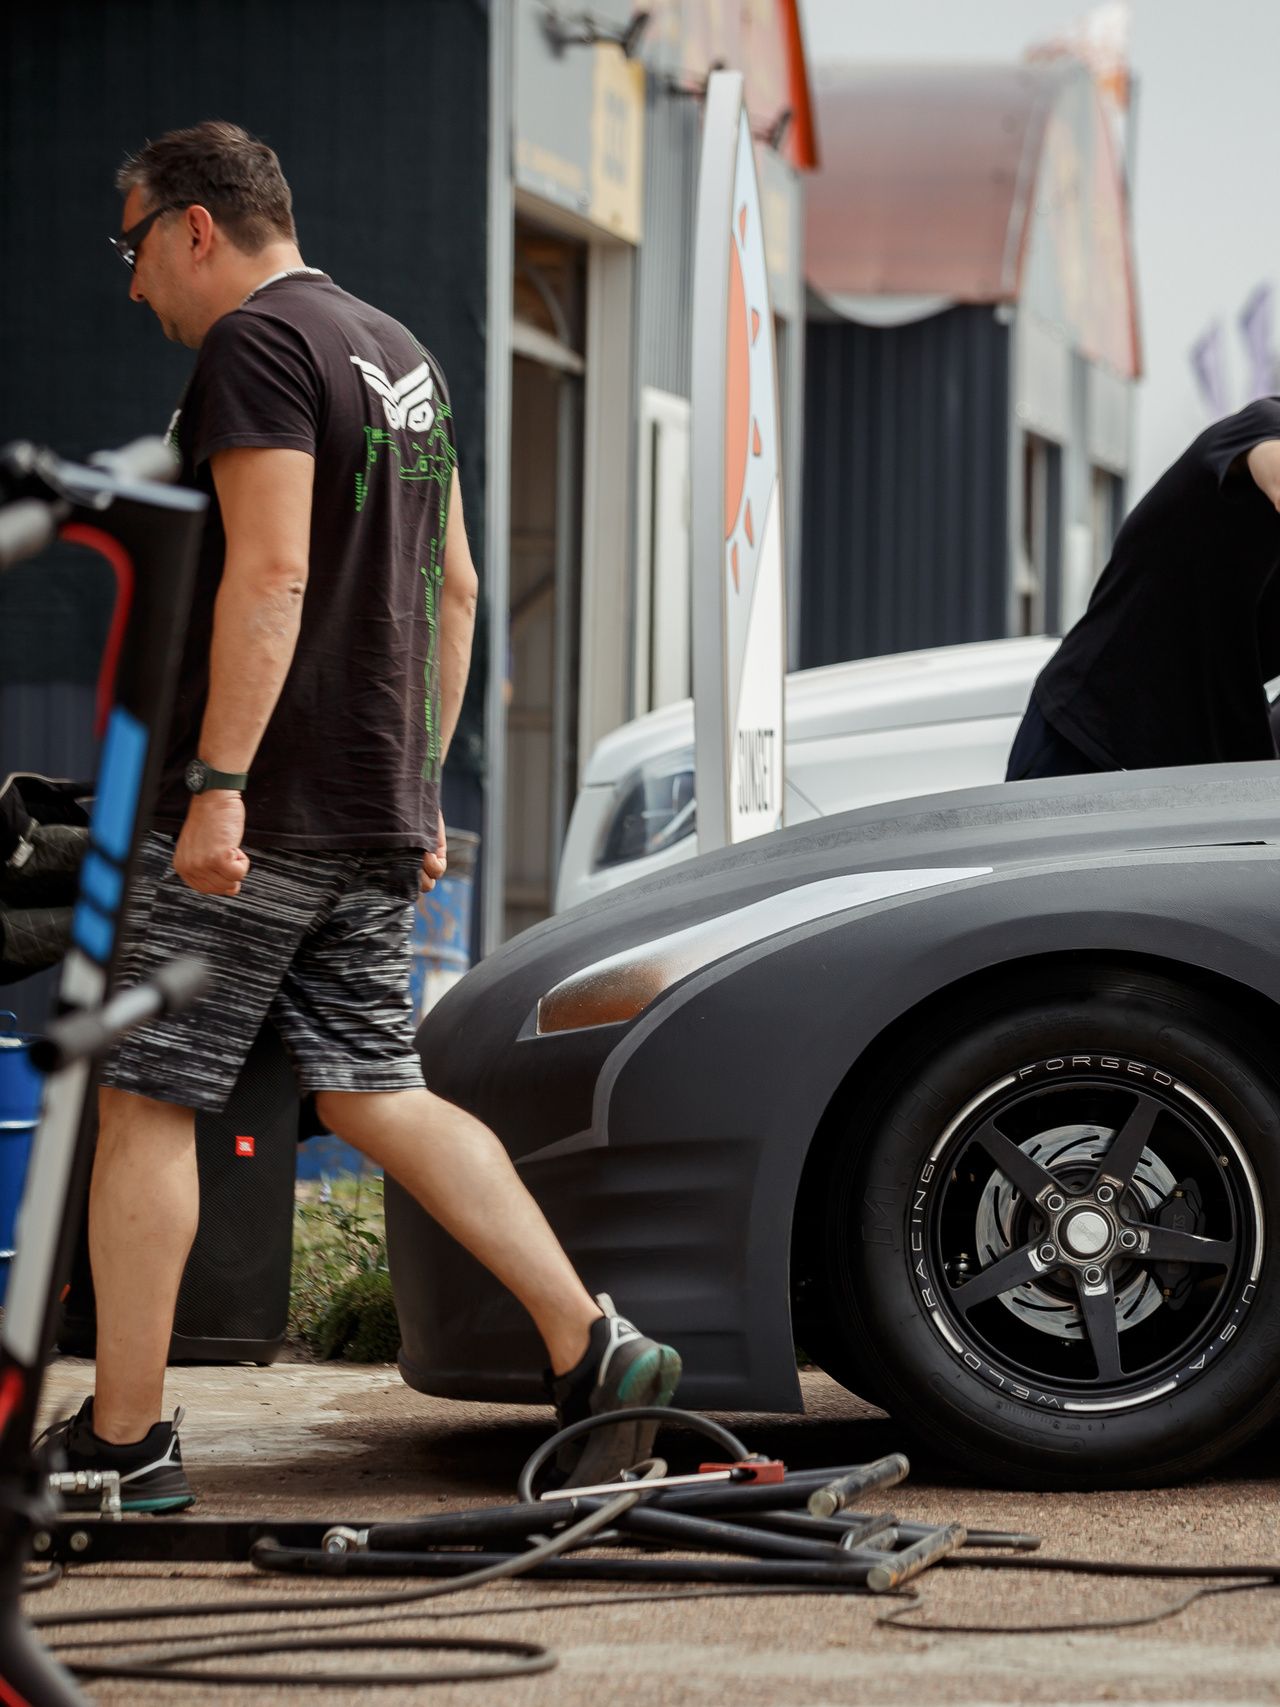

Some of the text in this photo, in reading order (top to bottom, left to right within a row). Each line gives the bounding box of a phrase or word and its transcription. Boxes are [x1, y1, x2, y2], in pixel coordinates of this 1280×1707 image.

[737, 729, 774, 814] SUNSET
[1018, 1055, 1173, 1087] FORGED
[910, 1162, 936, 1308] RACING
[1175, 1284, 1257, 1379] U.S.A.
[963, 1352, 1061, 1409] WELD
